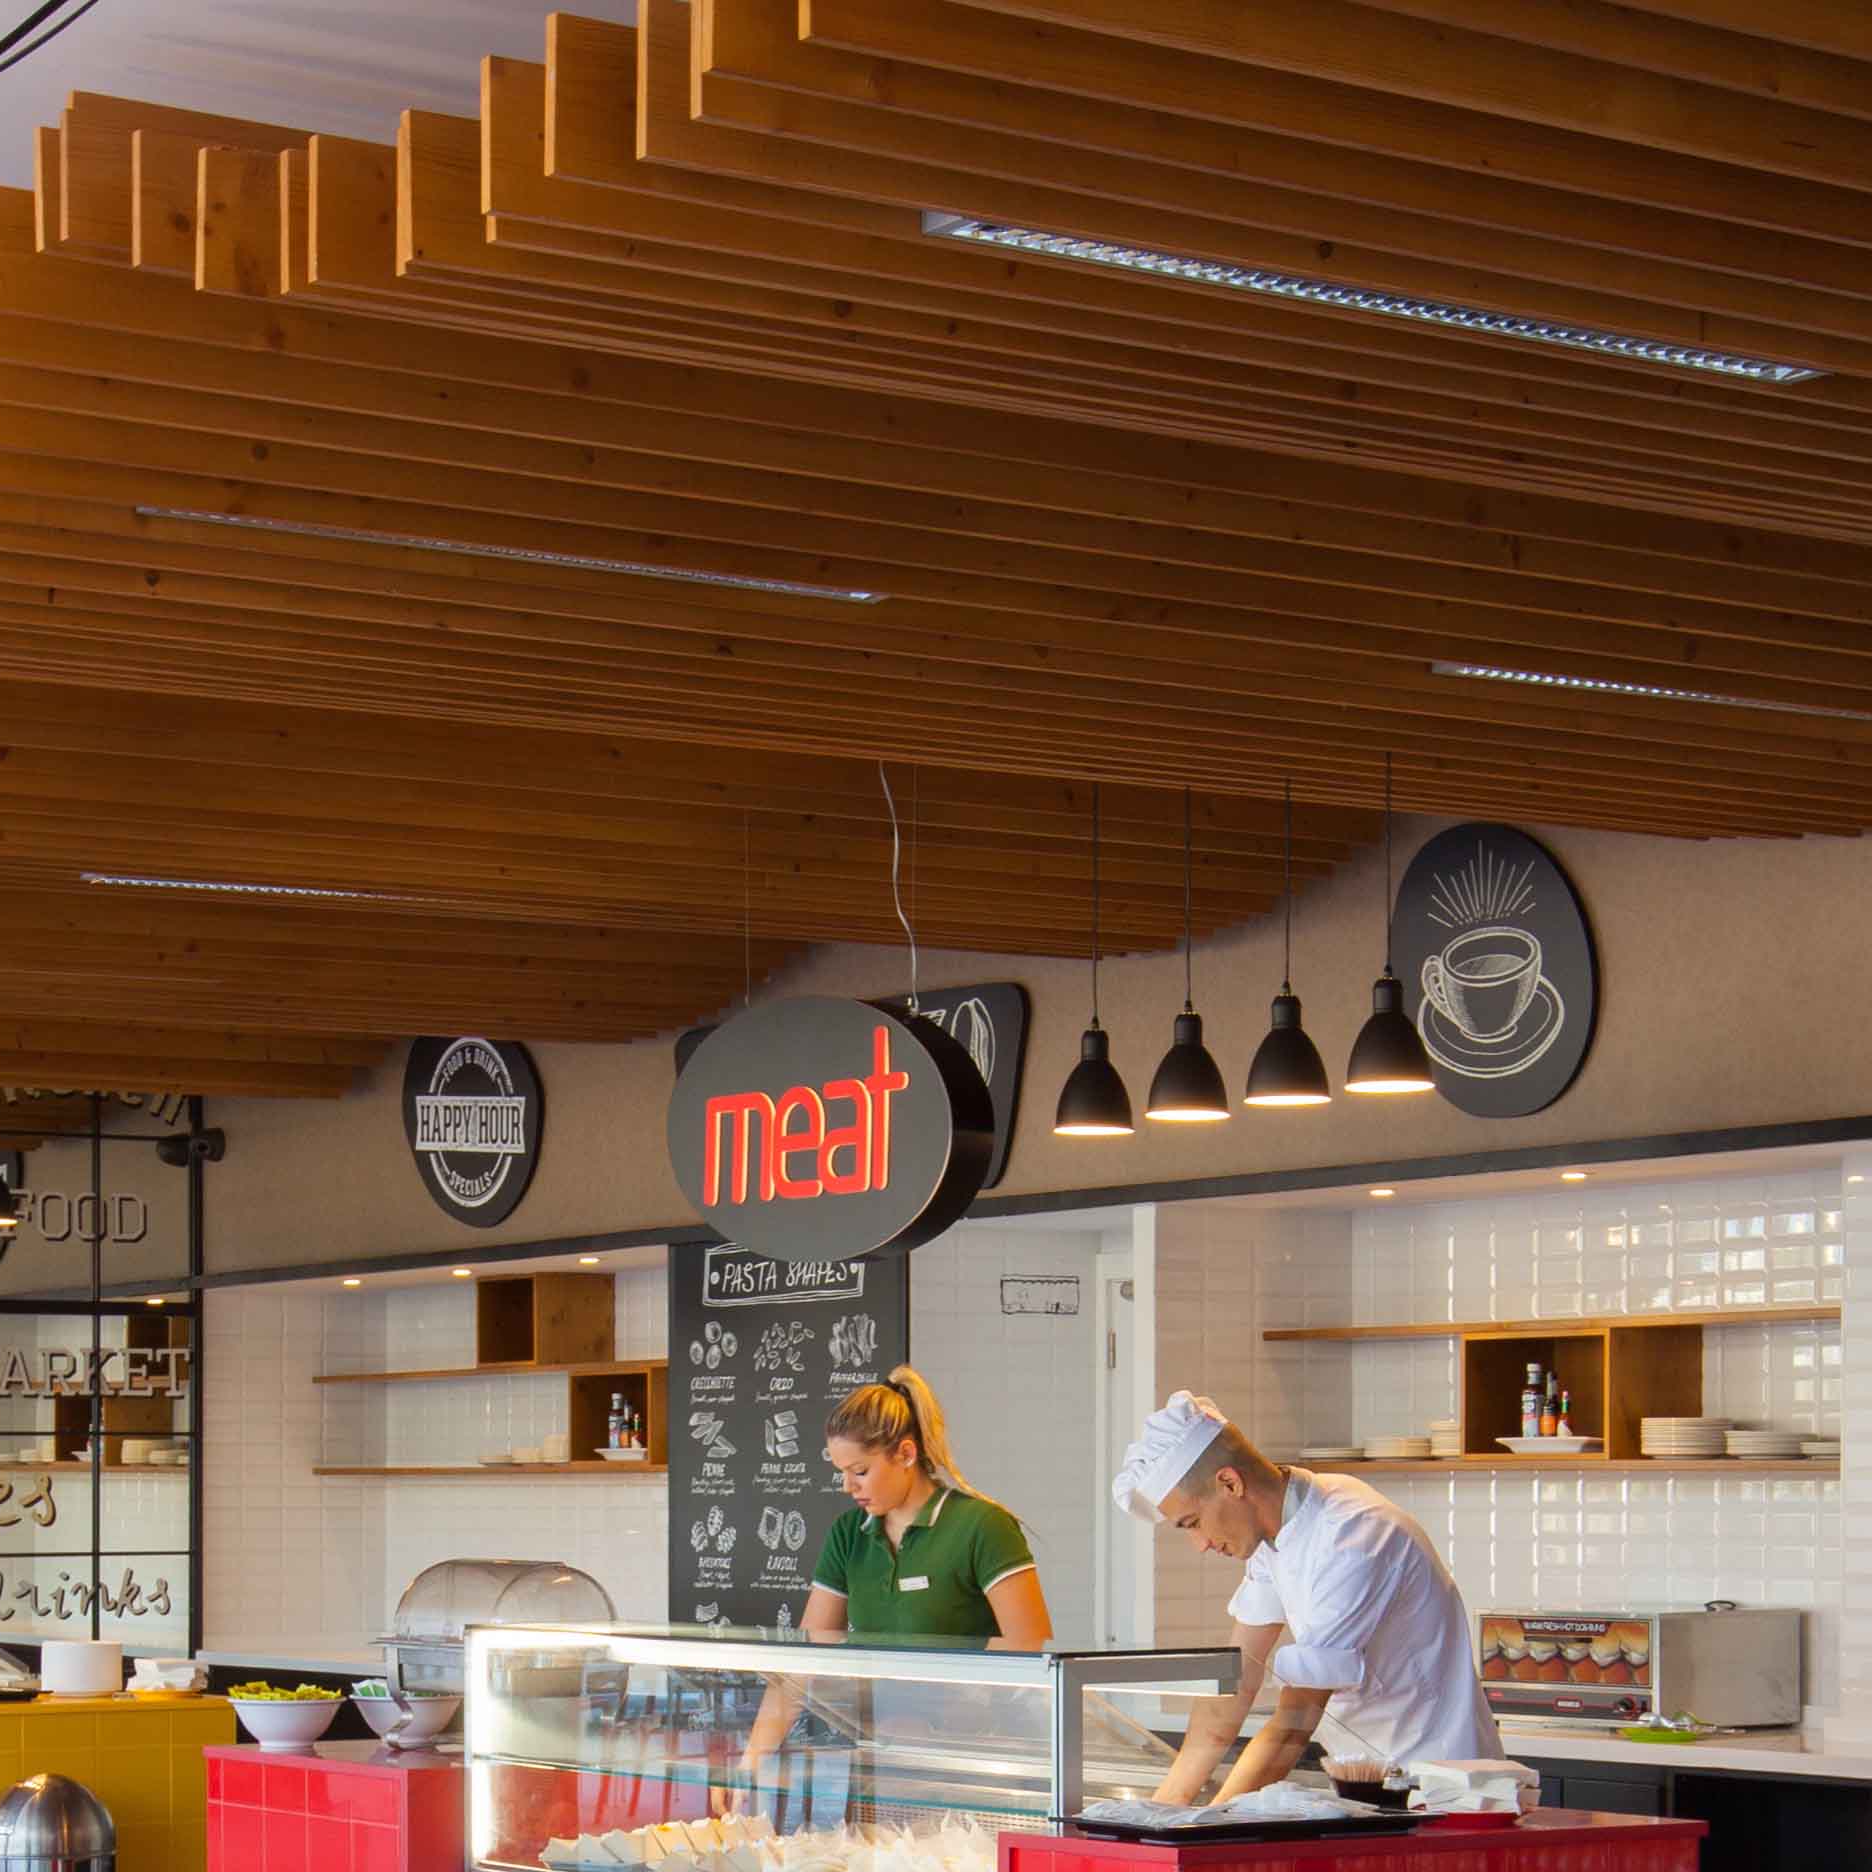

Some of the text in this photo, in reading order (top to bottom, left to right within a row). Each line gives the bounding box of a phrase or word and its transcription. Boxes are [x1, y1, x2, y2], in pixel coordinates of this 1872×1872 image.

[442, 1047, 501, 1082] FOOD & DRINK
[420, 1105, 521, 1145] HAPPY HOUR
[703, 1025, 910, 1207] meat
[448, 1171, 492, 1197] SPECIALS
[721, 1261, 777, 1293] PASTA
